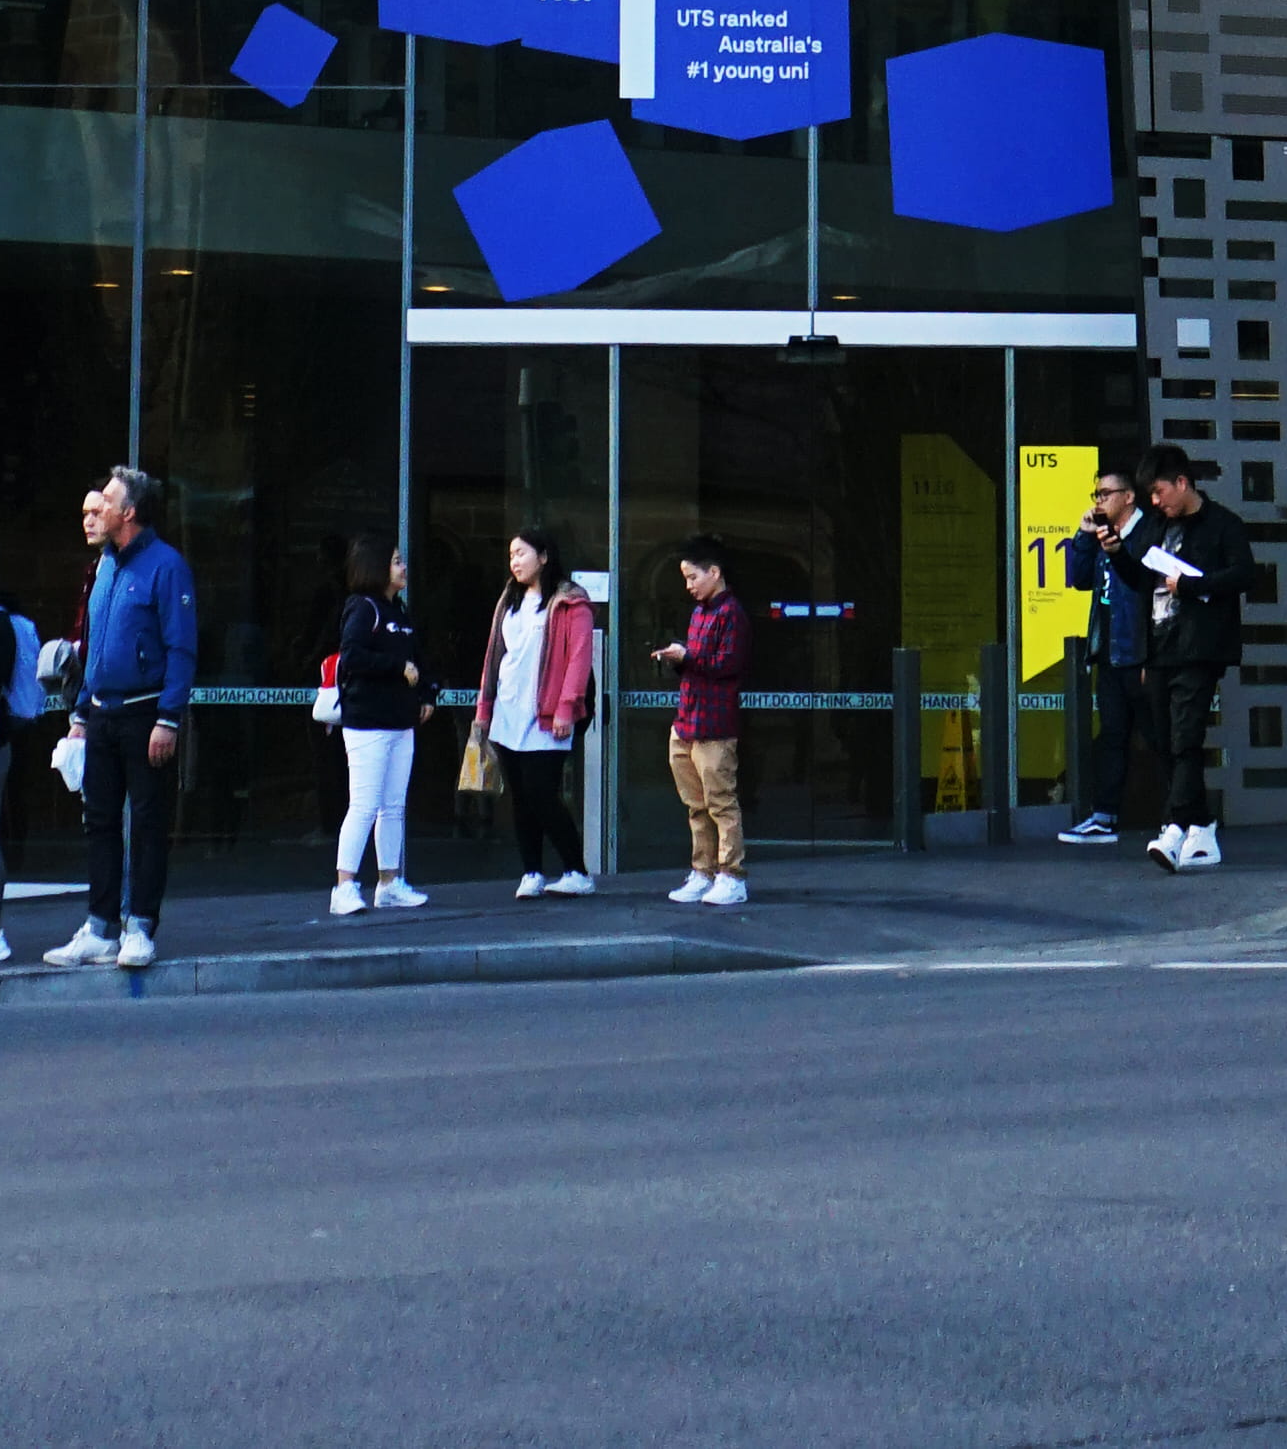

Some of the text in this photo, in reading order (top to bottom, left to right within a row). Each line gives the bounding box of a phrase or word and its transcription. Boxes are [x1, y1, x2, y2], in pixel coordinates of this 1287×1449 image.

[676, 9, 788, 28] UTS ranked
[717, 35, 823, 54] Australia's
[686, 61, 810, 84] #1 young uni
[1026, 453, 1058, 468] UTS
[1027, 525, 1071, 534] BUILDING
[1028, 537, 1075, 589] 11
